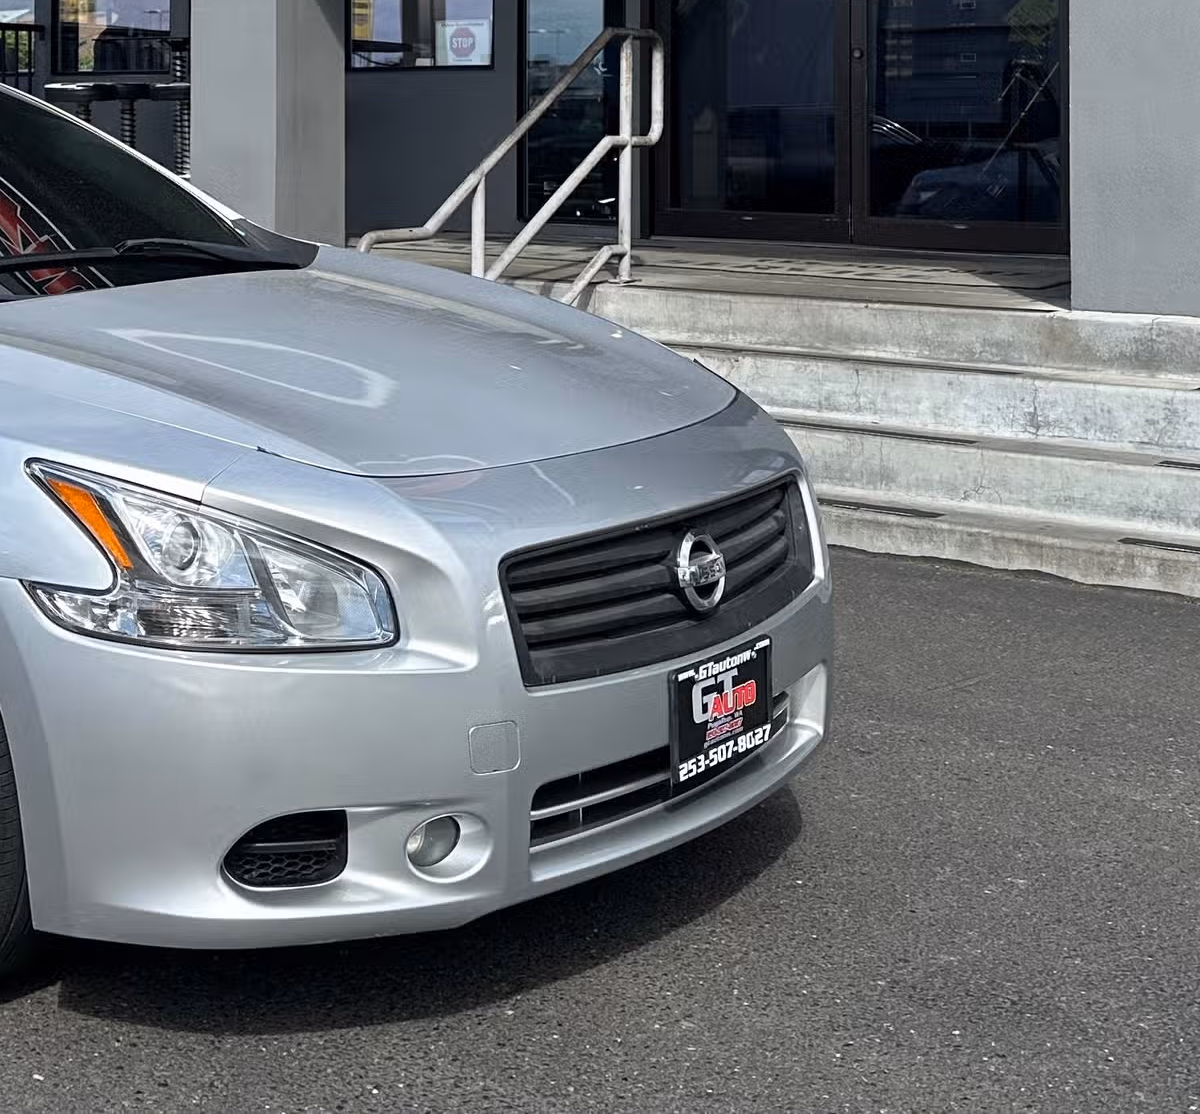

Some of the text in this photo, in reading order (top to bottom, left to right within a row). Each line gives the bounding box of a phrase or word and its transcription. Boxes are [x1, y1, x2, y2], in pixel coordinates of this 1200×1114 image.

[452, 37, 474, 49] STOP
[692, 669, 739, 724] GT
[708, 679, 757, 722] AUTO
[679, 723, 772, 782] 253-507-8027
